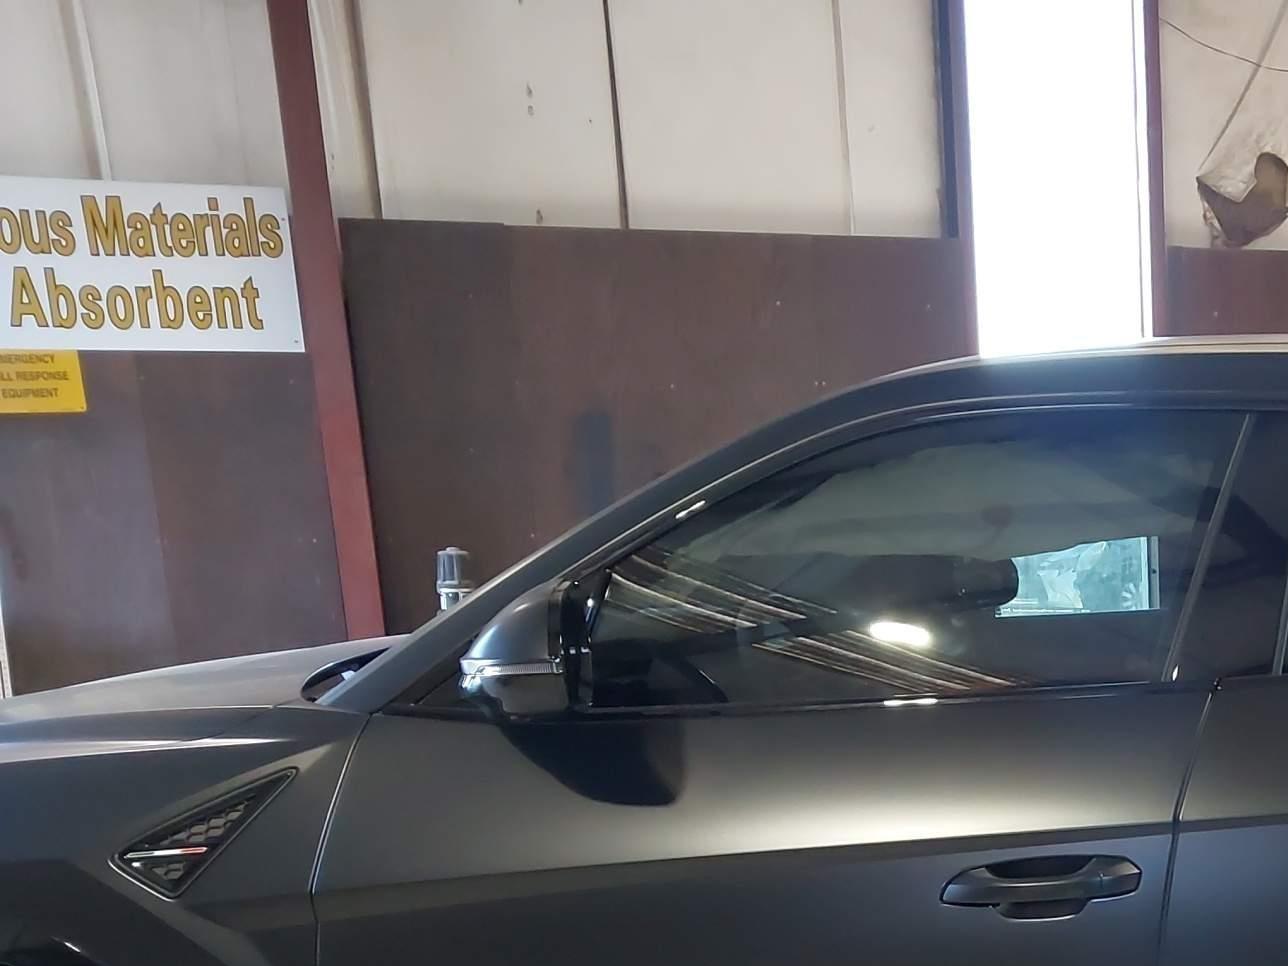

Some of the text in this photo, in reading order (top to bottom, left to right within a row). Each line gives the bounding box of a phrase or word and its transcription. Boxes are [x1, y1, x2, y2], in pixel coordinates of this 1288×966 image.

[0, 195, 284, 258] ous Materials
[10, 266, 264, 330] Absorbent
[2, 387, 59, 398] EQUIPMENT
[16, 370, 69, 381] RESPONSE
